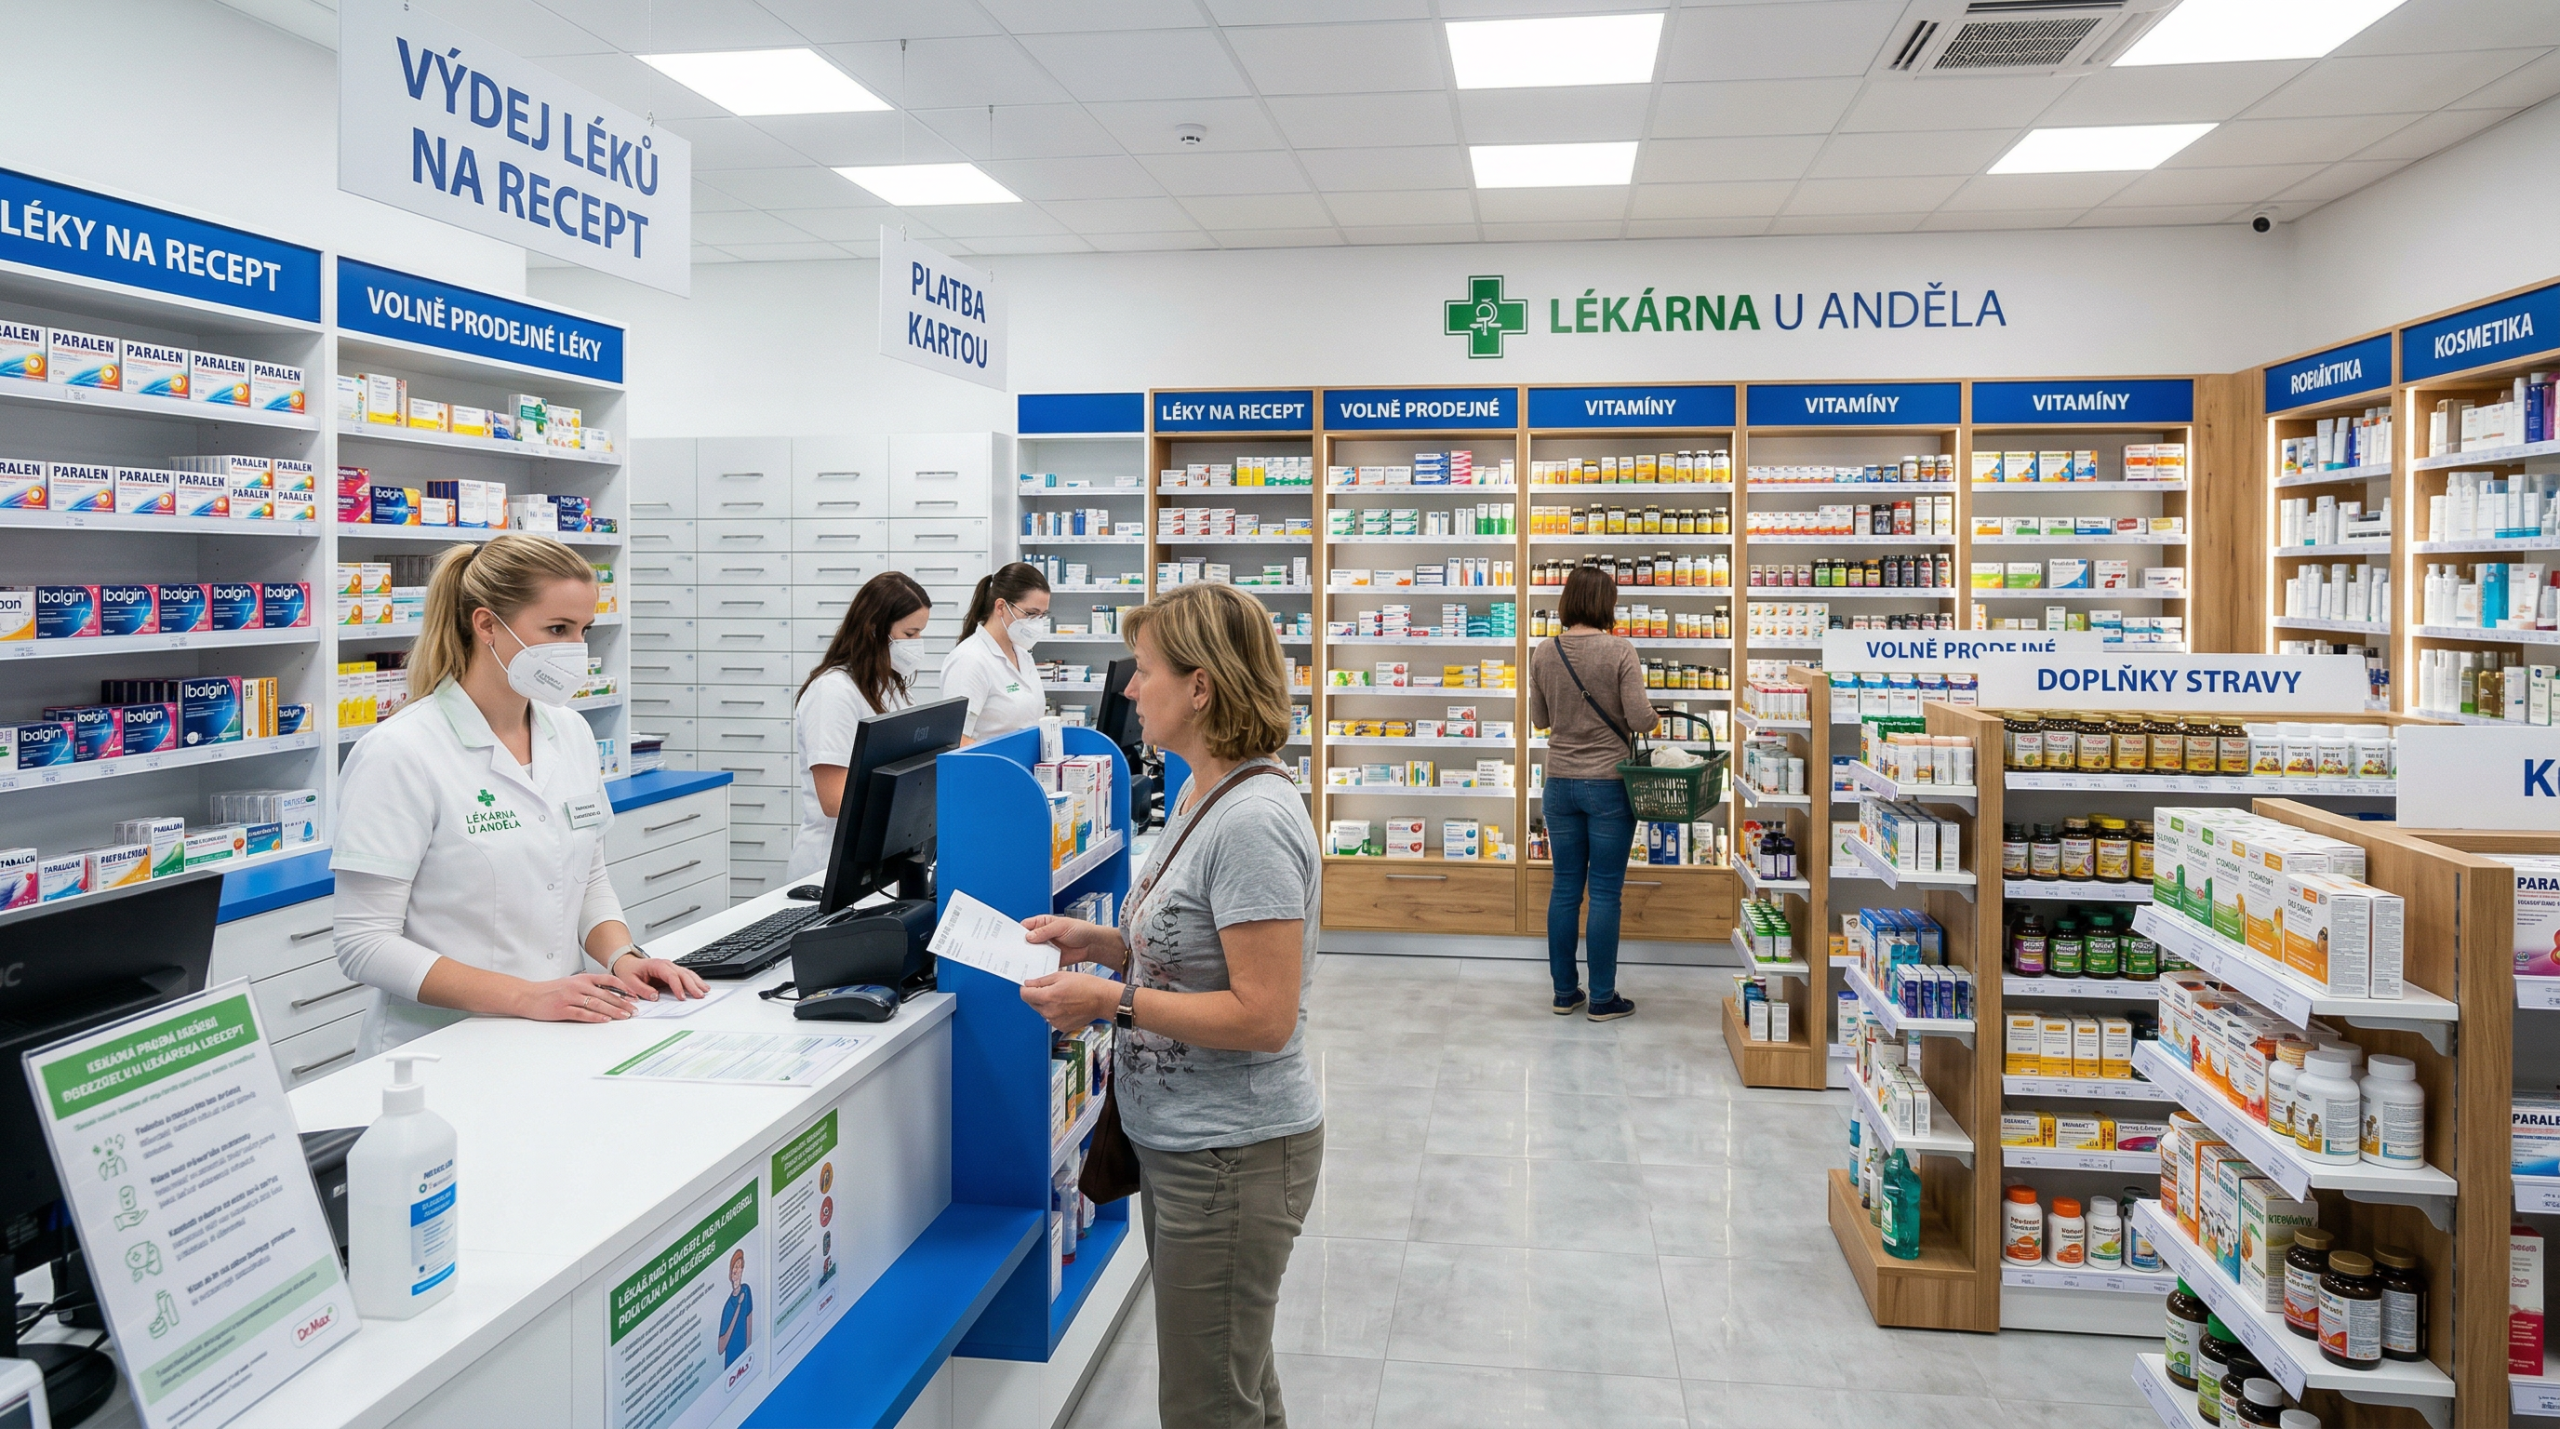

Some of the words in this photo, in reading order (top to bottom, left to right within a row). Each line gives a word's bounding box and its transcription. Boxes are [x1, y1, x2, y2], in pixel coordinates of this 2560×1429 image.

[396, 36, 550, 151] VÝDEJ
[563, 115, 659, 196] LÉKŮ
[412, 126, 485, 206] NA
[498, 160, 649, 259] RECEPT
[0, 199, 97, 251] LÉKY
[106, 224, 157, 266] NA
[165, 238, 282, 292] RECEPT
[911, 260, 987, 324] PLATBA
[1550, 287, 1761, 334] LÉKÁRNA
[1774, 293, 1804, 331] U
[1818, 281, 2007, 330] ANDĚLA
[366, 286, 446, 329] VOLNĚ
[451, 306, 555, 353] PRODEJNÉ
[559, 330, 602, 363] LÉKY
[52, 332, 114, 353] PARALEN
[908, 310, 988, 370] KARTOU
[2433, 313, 2535, 360] KOSMETIKA
[126, 344, 183, 364] PARALEN
[193, 355, 245, 373] PARALEN
[254, 364, 301, 382] PARALEN
[1340, 399, 1401, 419] VOLNĚ
[1405, 398, 1500, 418] PRODEJNÉ
[1584, 394, 1677, 416] VITAMÍNY
[1804, 393, 1900, 414] VITAMÍNY
[2032, 390, 2130, 412] VITAMÍNY
[1162, 402, 1205, 421] LÉKY
[1209, 404, 1235, 420] NA
[1239, 403, 1305, 420] RECEPT
[230, 456, 269, 469] PARALEN
[276, 460, 313, 473] PARALEN
[53, 465, 109, 481] PARALEN
[118, 470, 170, 484] PARALEN
[178, 474, 226, 488] PARALEN
[232, 488, 270, 500] PARALEN
[38, 588, 85, 606] Ibalgin
[102, 587, 146, 604] Ibalgin
[213, 586, 251, 601] Ibalgin
[1866, 637, 1938, 659] VOLNĚ
[2037, 665, 2178, 692] DOPLŇKY
[2186, 670, 2302, 694] STRAVY
[184, 683, 227, 700] Ibalgin
[124, 709, 163, 726] Ibalgin
[20, 727, 62, 743] Ibalgin
[2524, 758, 2560, 797] K
[467, 825, 476, 835] U
